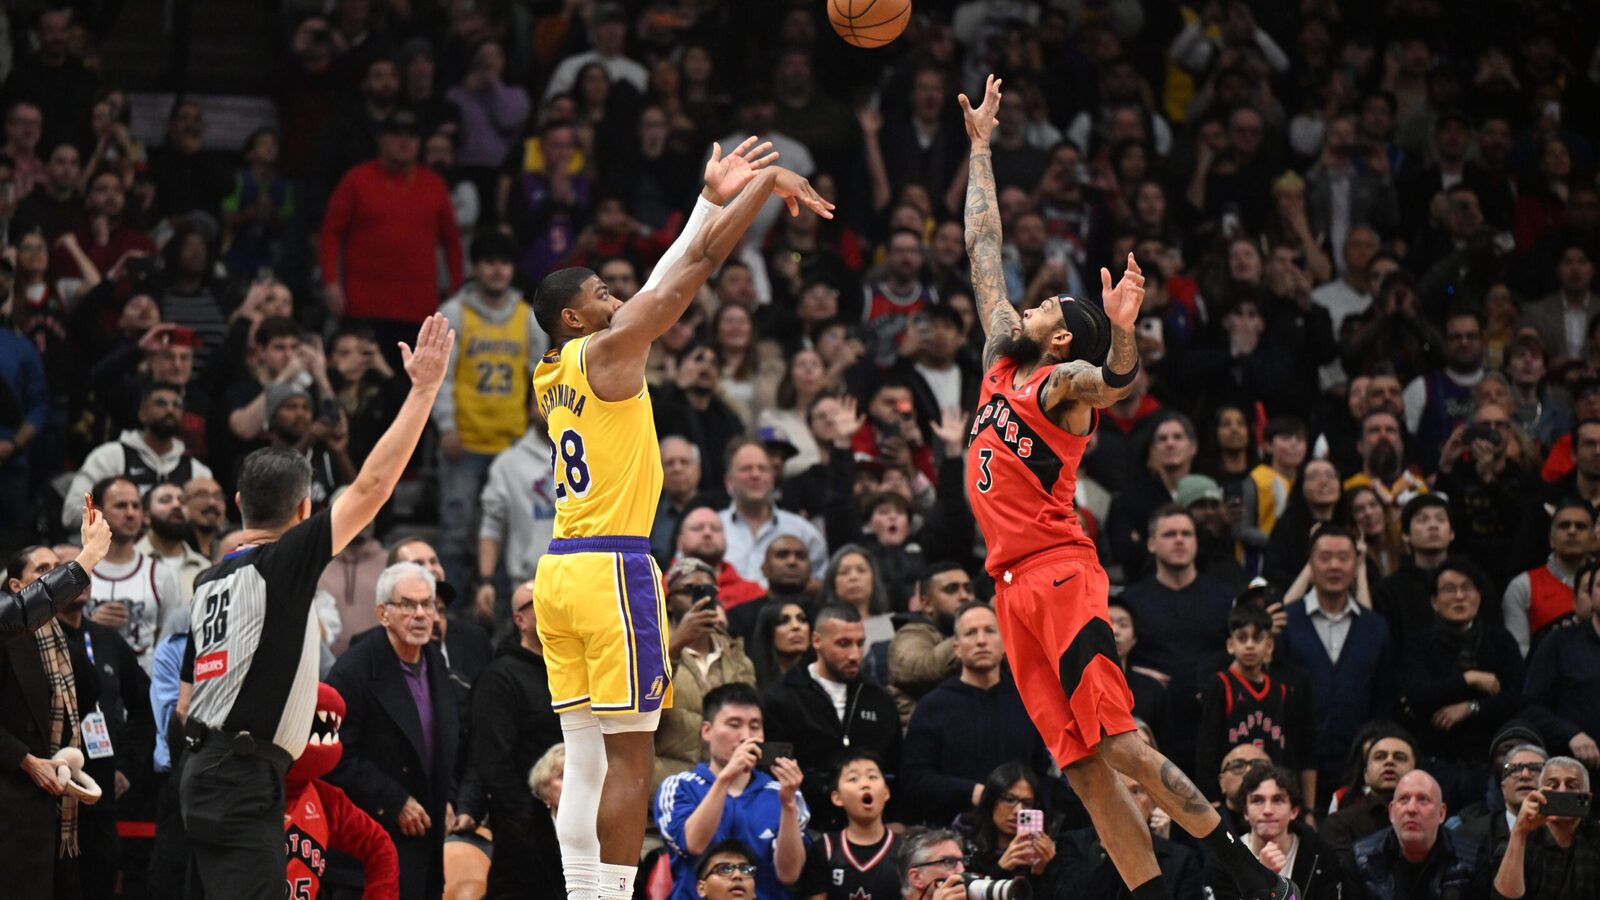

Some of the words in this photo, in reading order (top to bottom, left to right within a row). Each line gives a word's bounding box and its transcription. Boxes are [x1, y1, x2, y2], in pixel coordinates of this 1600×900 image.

[476, 361, 514, 395] 23
[969, 400, 1033, 458] APTORS
[977, 448, 993, 493] 3
[202, 588, 231, 649] 26
[285, 833, 326, 877] TORS
[832, 868, 845, 886] 9
